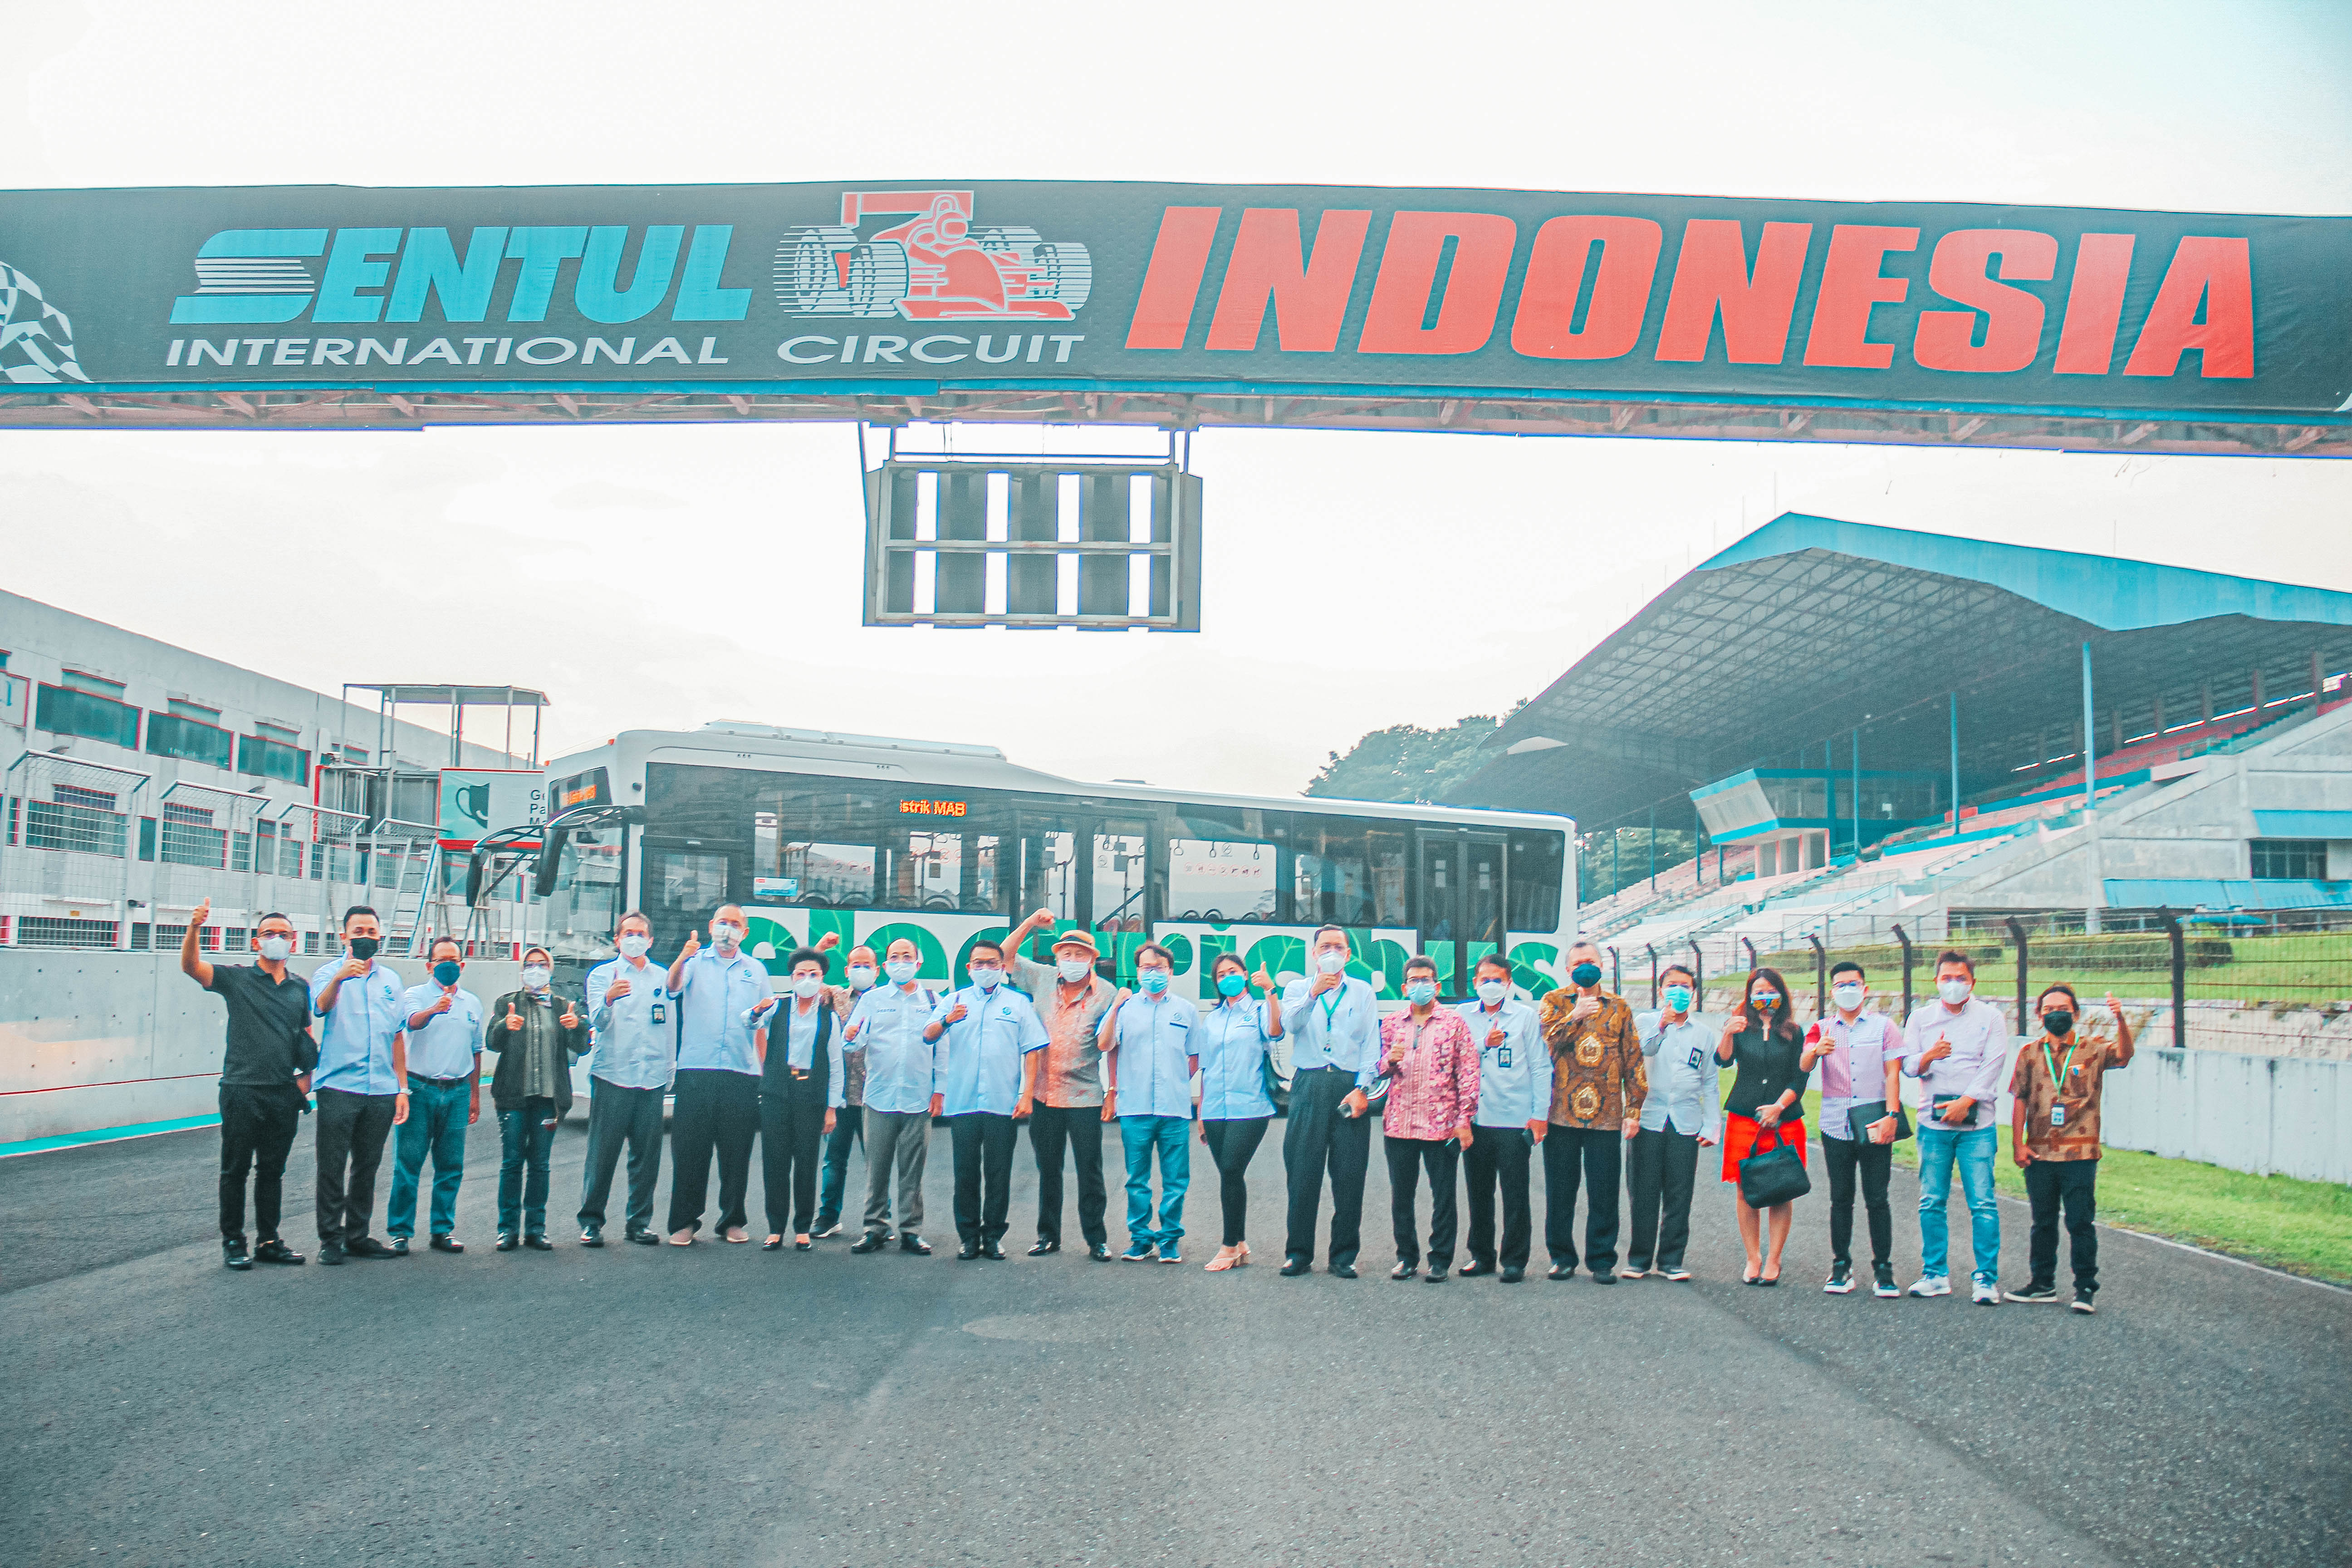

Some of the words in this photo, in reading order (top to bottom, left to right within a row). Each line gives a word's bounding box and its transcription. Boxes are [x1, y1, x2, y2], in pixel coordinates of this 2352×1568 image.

[167, 224, 753, 324] SENTUL
[1125, 206, 2254, 378] INDONESIA
[167, 336, 729, 366] INTERNATIONAL
[777, 334, 1085, 364] CIRCUIT
[933, 800, 966, 817] MAB
